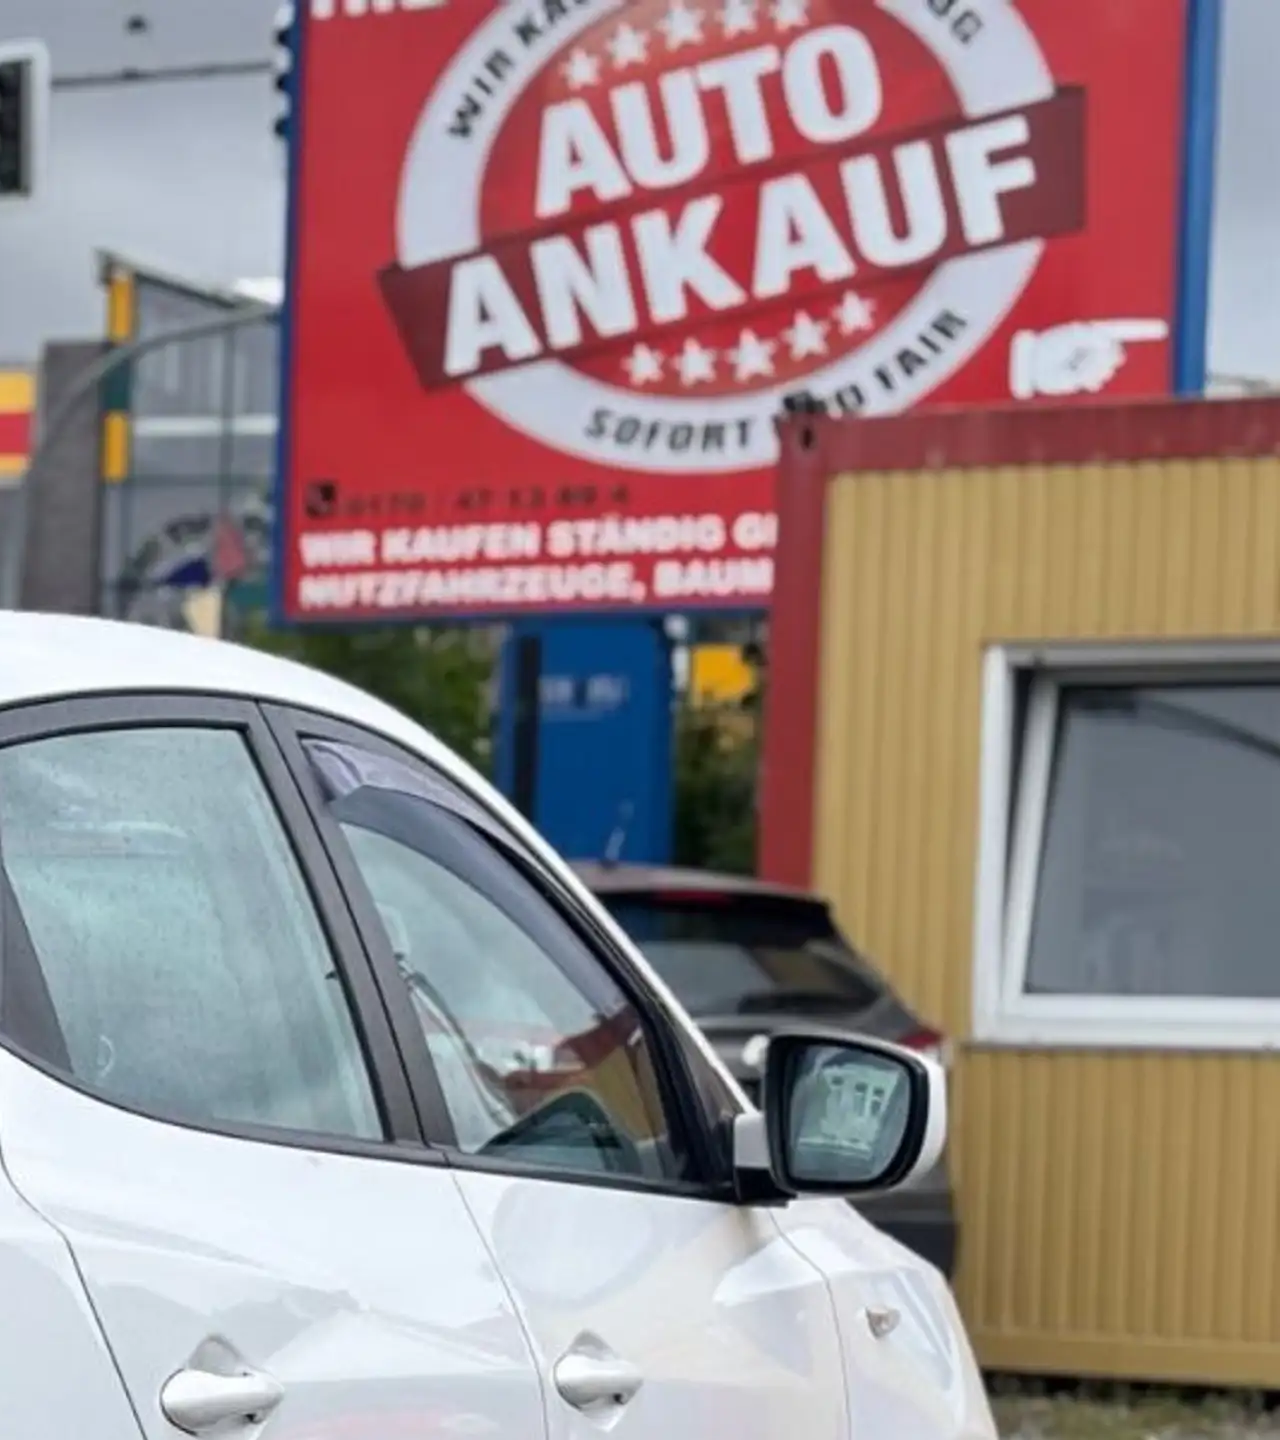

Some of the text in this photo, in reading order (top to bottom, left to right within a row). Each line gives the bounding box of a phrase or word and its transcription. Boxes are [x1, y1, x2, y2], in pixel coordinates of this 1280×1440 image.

[447, 49, 515, 140] WIR
[535, 24, 882, 218] AUTO
[443, 114, 1037, 376] ANKAUF
[584, 309, 968, 453] SOFORT FAIR
[300, 529, 376, 568] WIR
[381, 521, 542, 565] KAUFEN
[546, 512, 727, 558] STÄNDIG
